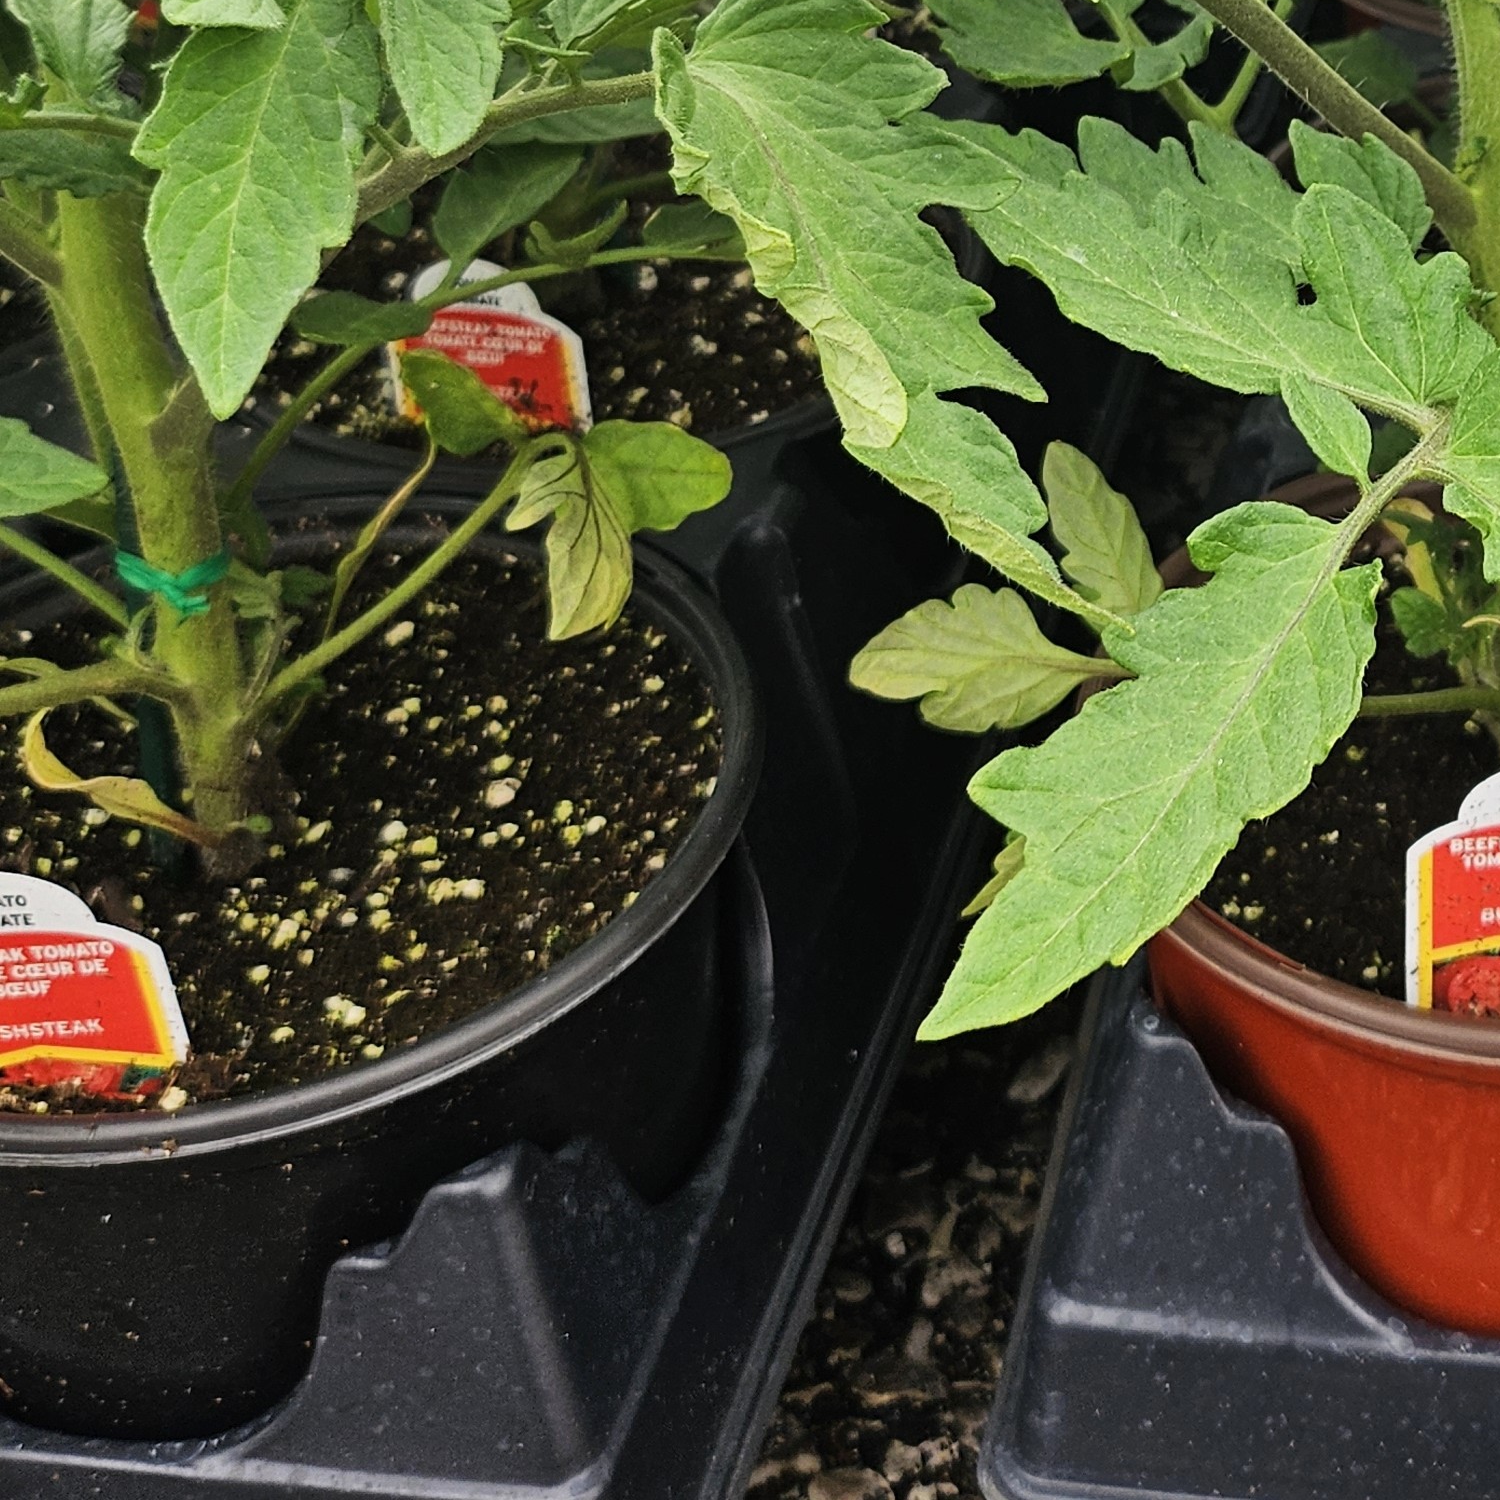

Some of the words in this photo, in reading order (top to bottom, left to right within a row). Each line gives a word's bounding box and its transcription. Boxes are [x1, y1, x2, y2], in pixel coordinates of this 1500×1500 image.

[30, 941, 115, 960] TOMATO
[11, 961, 75, 979] CŒUR
[78, 958, 109, 976] DE
[0, 1017, 104, 1040] SHSTEAK
